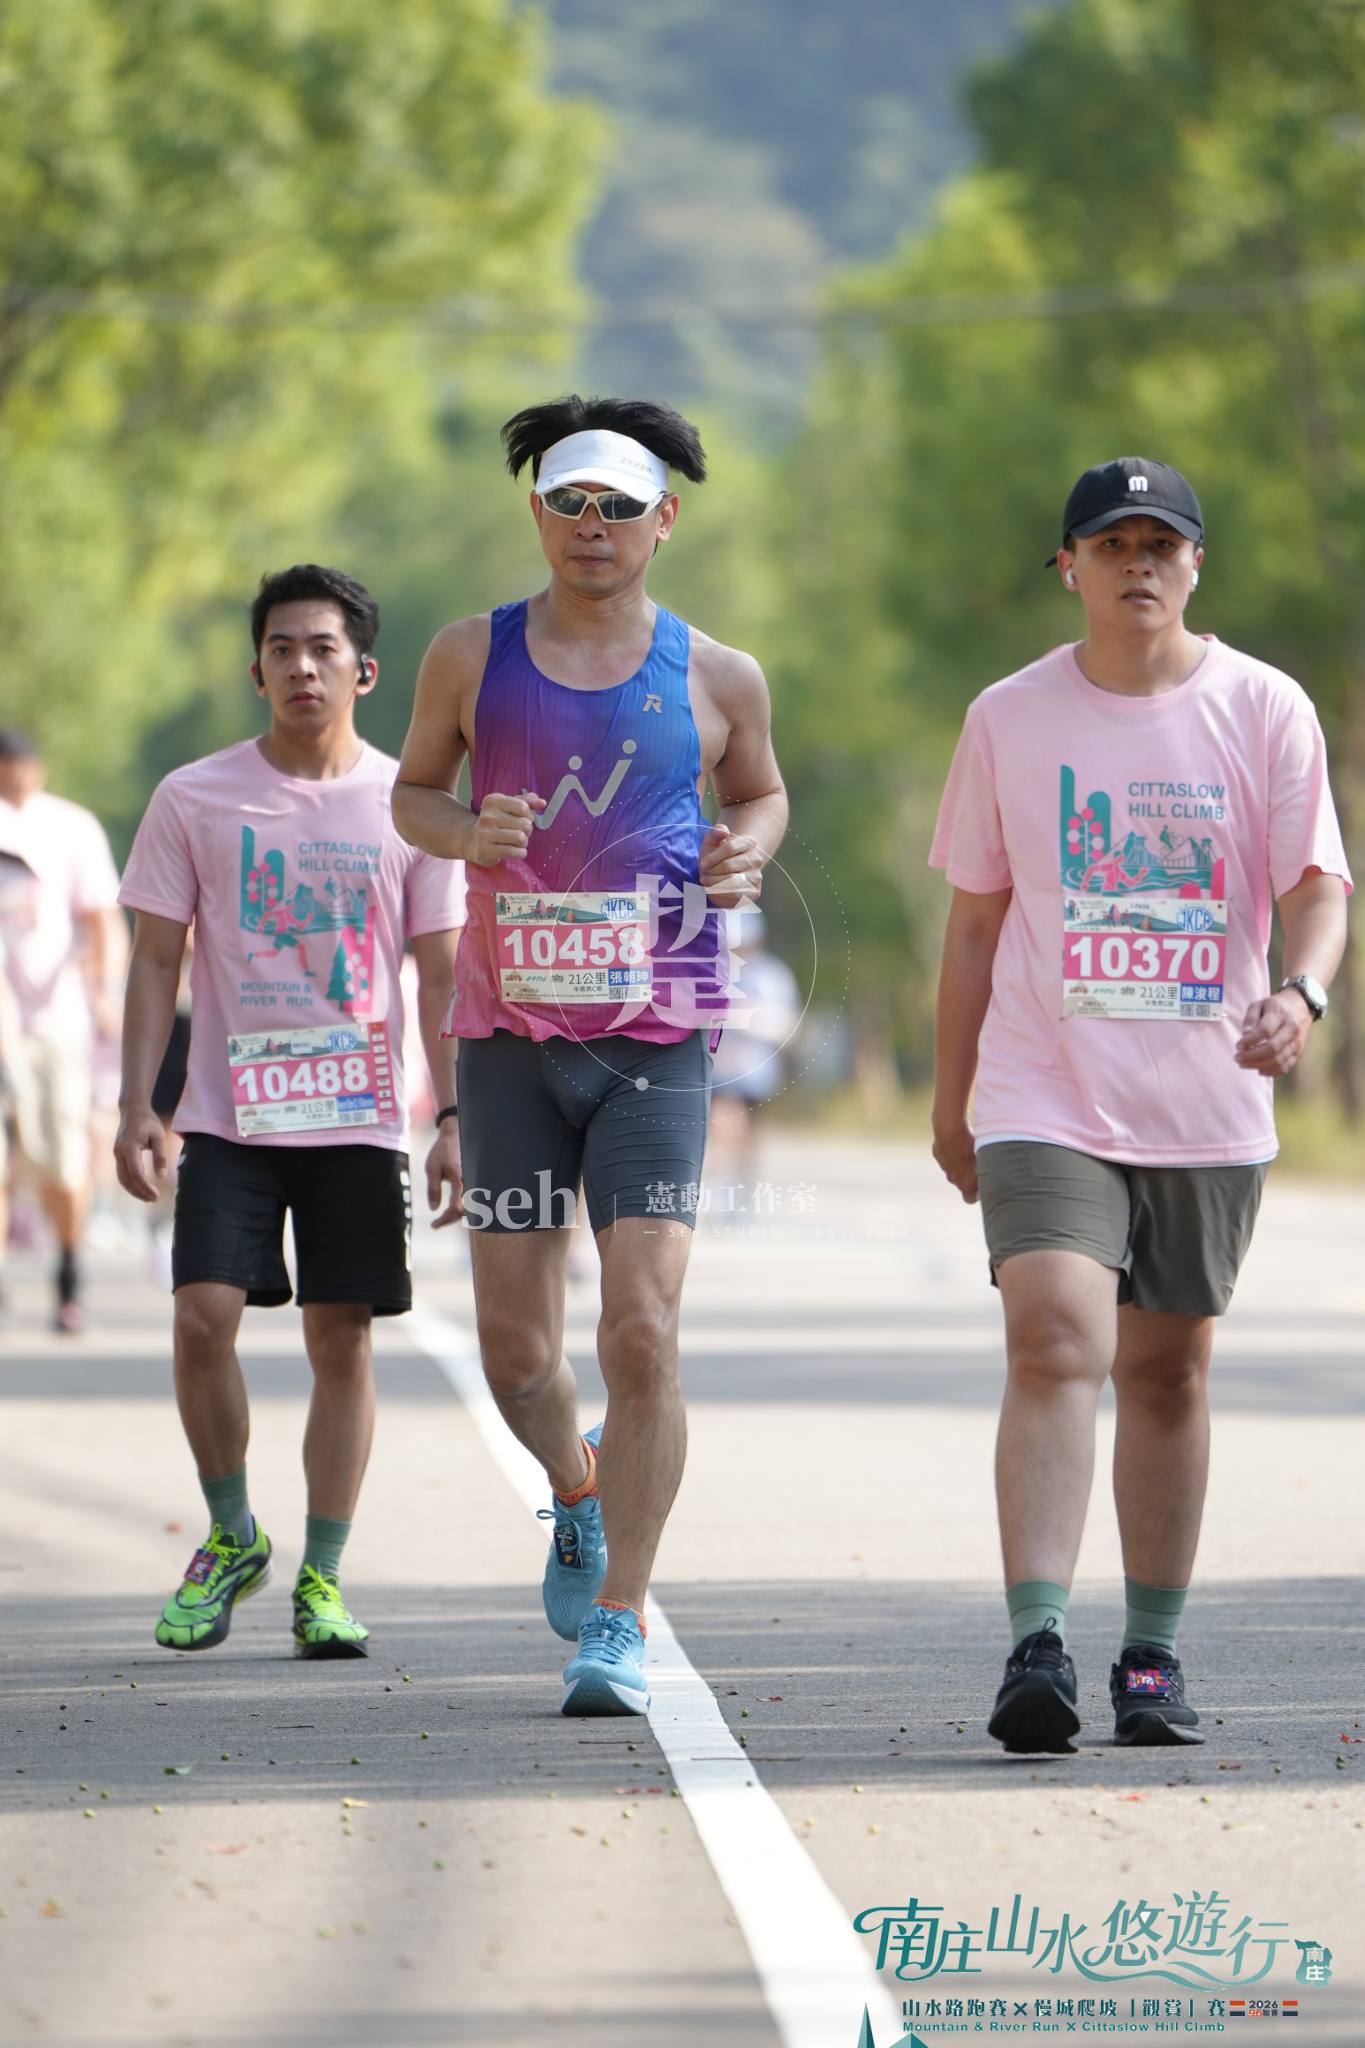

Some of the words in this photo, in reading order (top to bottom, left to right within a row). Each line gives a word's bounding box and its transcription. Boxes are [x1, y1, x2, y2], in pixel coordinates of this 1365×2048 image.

[1128, 475, 1148, 492] m
[1128, 781, 1226, 798] CITTASLOW
[1128, 803, 1165, 818] HILL
[1171, 804, 1225, 821] CLIMB
[298, 841, 382, 858] CITTASLOW
[298, 859, 330, 872] HILL
[334, 860, 378, 876] CLIMB
[503, 928, 645, 966] 10458
[1070, 936, 1220, 981] 10370
[568, 971, 607, 985] 21公里
[240, 981, 301, 993] MOUNTAIN
[304, 982, 313, 993] &
[1140, 986, 1178, 999] 21公里
[240, 996, 277, 1007] RIVER
[286, 996, 313, 1007] RUN
[238, 1058, 369, 1103] 10488
